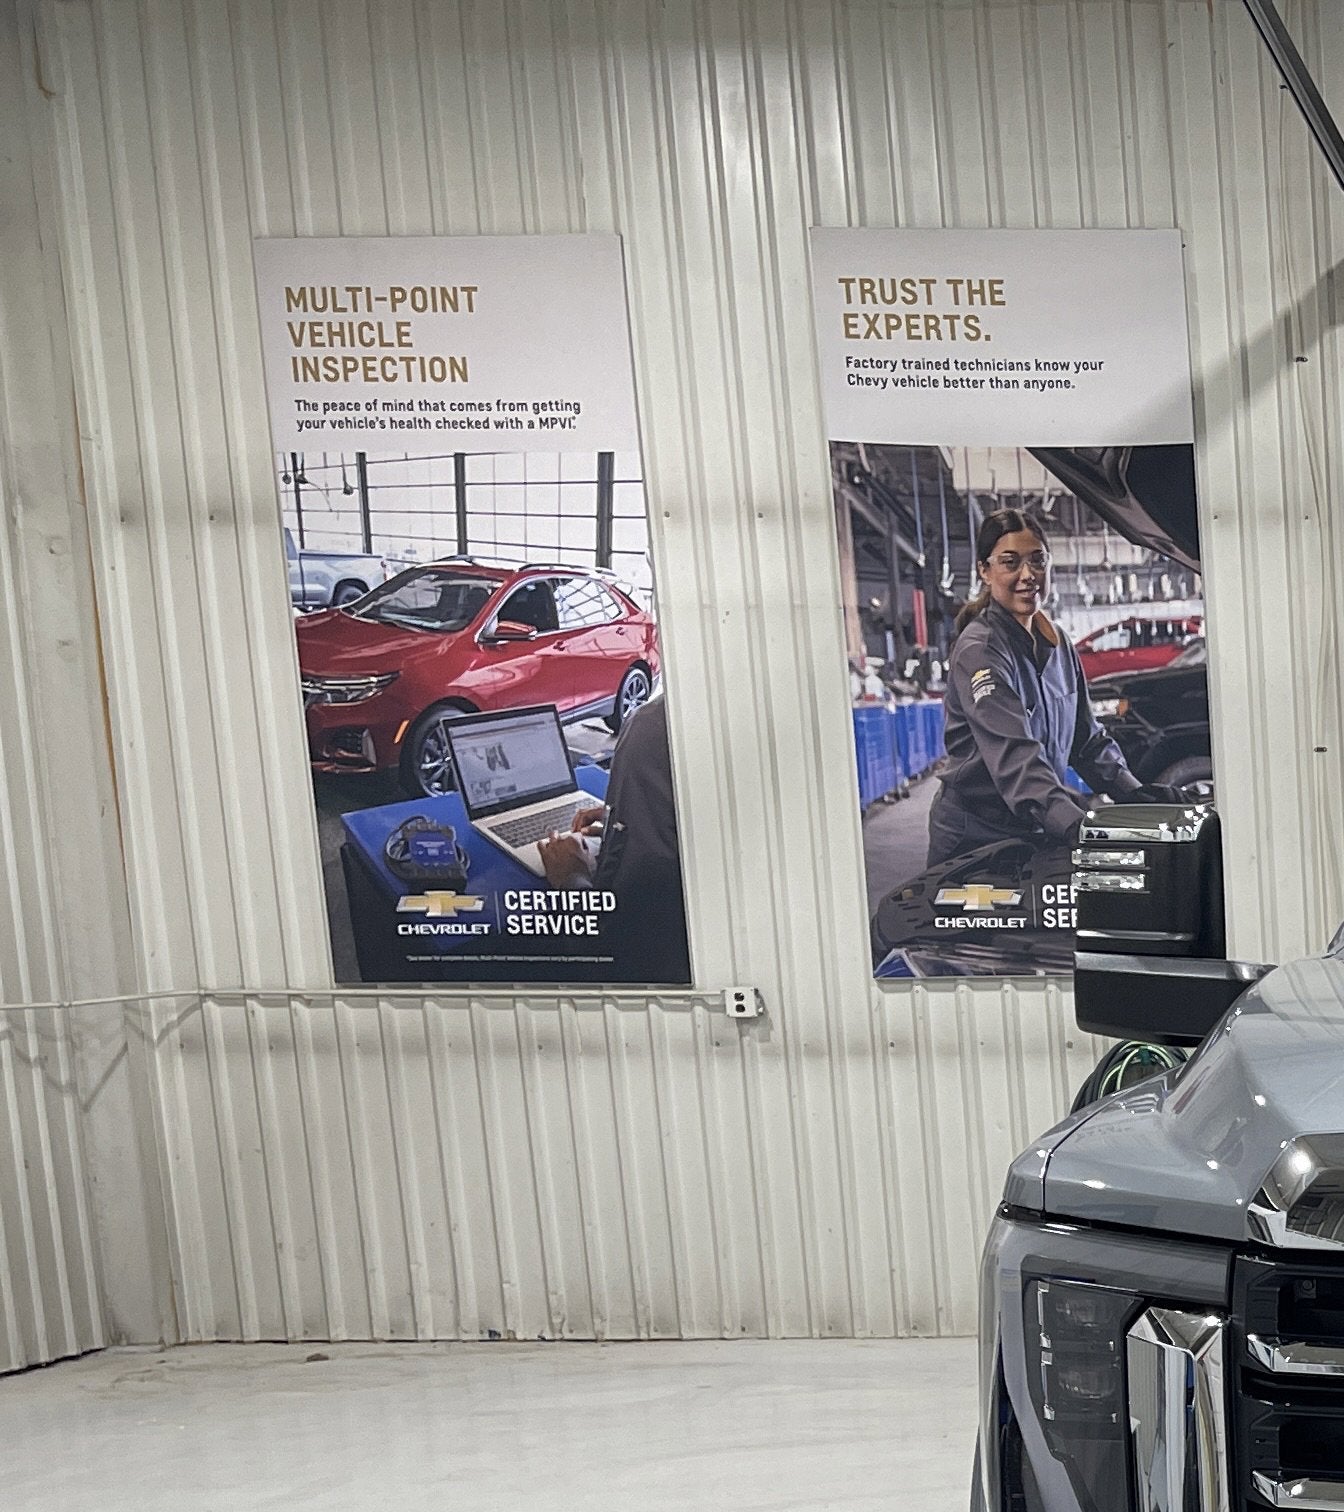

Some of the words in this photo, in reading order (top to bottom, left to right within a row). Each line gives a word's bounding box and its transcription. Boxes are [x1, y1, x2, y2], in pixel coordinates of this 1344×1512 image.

[285, 286, 479, 313] MULTI-POINT
[838, 278, 937, 306] TRUST
[946, 279, 1006, 306] THE
[287, 321, 414, 348] VEHICLE
[843, 313, 992, 342] EXPERTS.
[292, 356, 469, 383] INSPECTION
[846, 356, 898, 372] Factory
[902, 358, 950, 370] trained
[954, 358, 1031, 371] technicians
[1035, 359, 1070, 371] know
[1073, 361, 1104, 374] your
[847, 374, 888, 389] Chevy
[892, 375, 939, 388] vehicle
[943, 376, 985, 388] better
[989, 377, 1020, 389] than
[1024, 380, 1076, 392] anyone.
[294, 399, 319, 411] The
[323, 401, 361, 415] peace
[365, 399, 378, 411] of
[382, 399, 414, 411] mind
[418, 399, 446, 411] that
[449, 402, 492, 412] comes
[496, 399, 528, 411] from
[532, 399, 580, 414] getting
[296, 420, 326, 432] your
[330, 416, 386, 429] vehicle's
[390, 417, 431, 429] health
[435, 417, 490, 429] checked
[494, 417, 523, 429] with
[527, 420, 535, 429] a
[504, 890, 616, 912] CERTIFIED
[397, 924, 491, 935] CHEVROLET
[506, 915, 600, 935] SERVICE
[934, 917, 1028, 929] CHEVROLET
